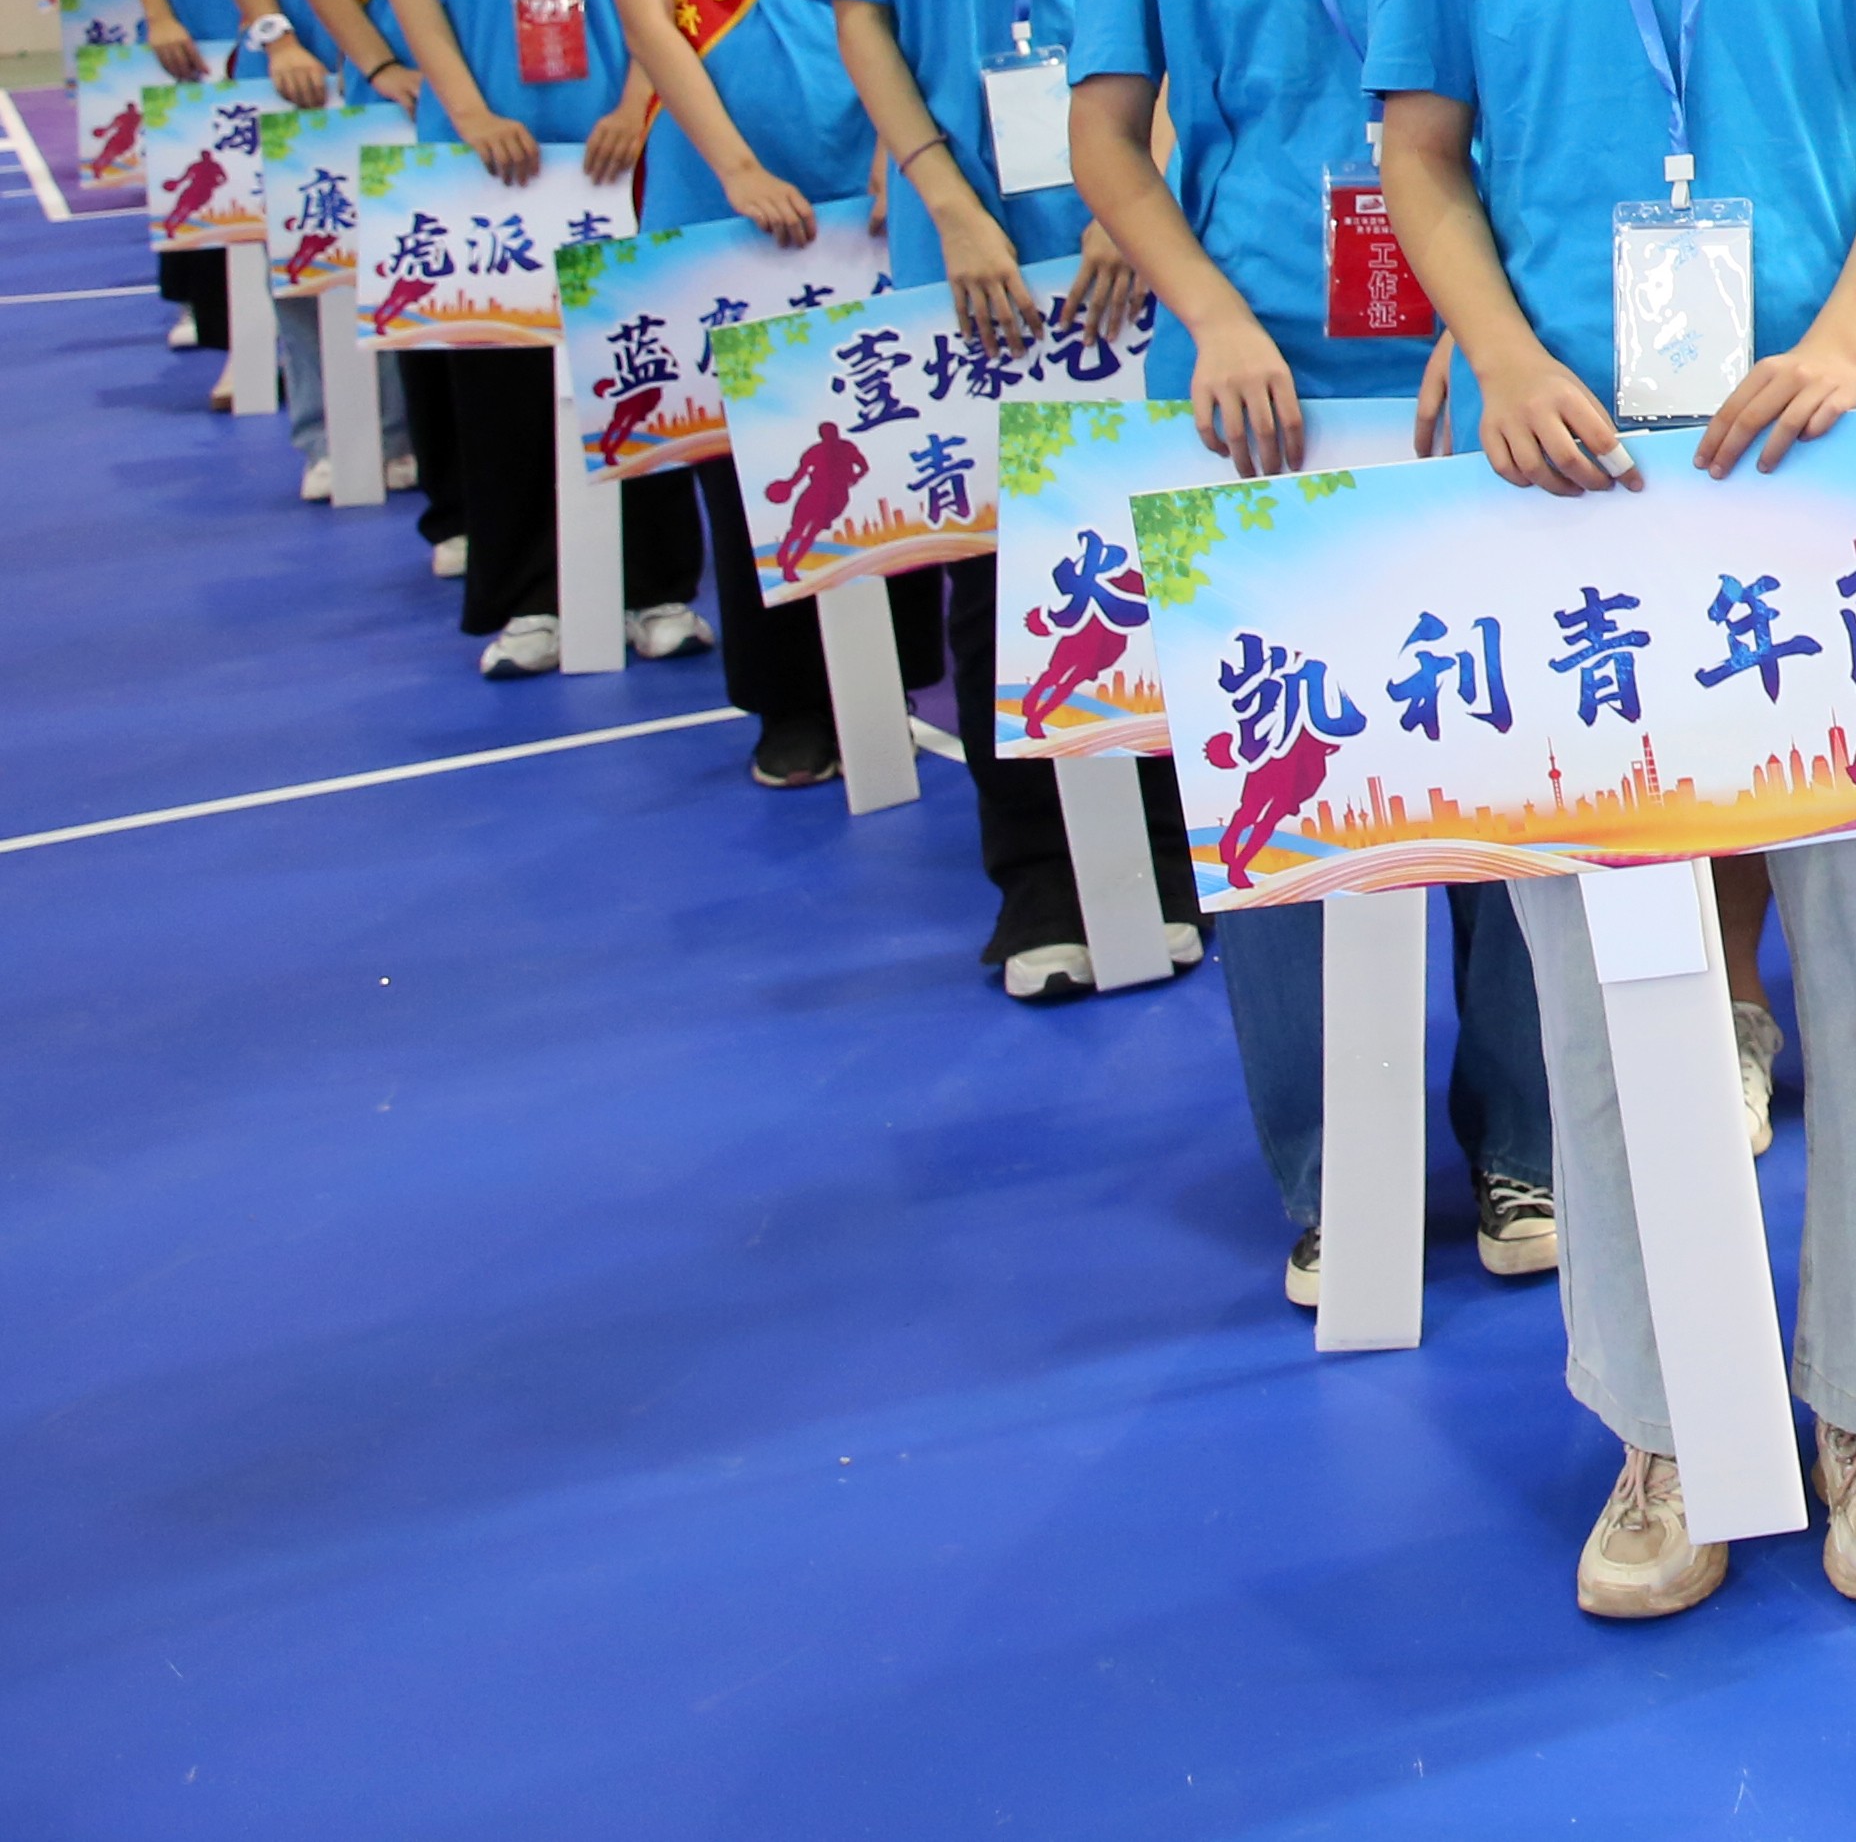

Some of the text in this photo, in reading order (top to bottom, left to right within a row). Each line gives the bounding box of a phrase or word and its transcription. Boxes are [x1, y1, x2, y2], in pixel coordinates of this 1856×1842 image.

[1367, 243, 1399, 329] 工作证
[906, 433, 976, 525] 青
